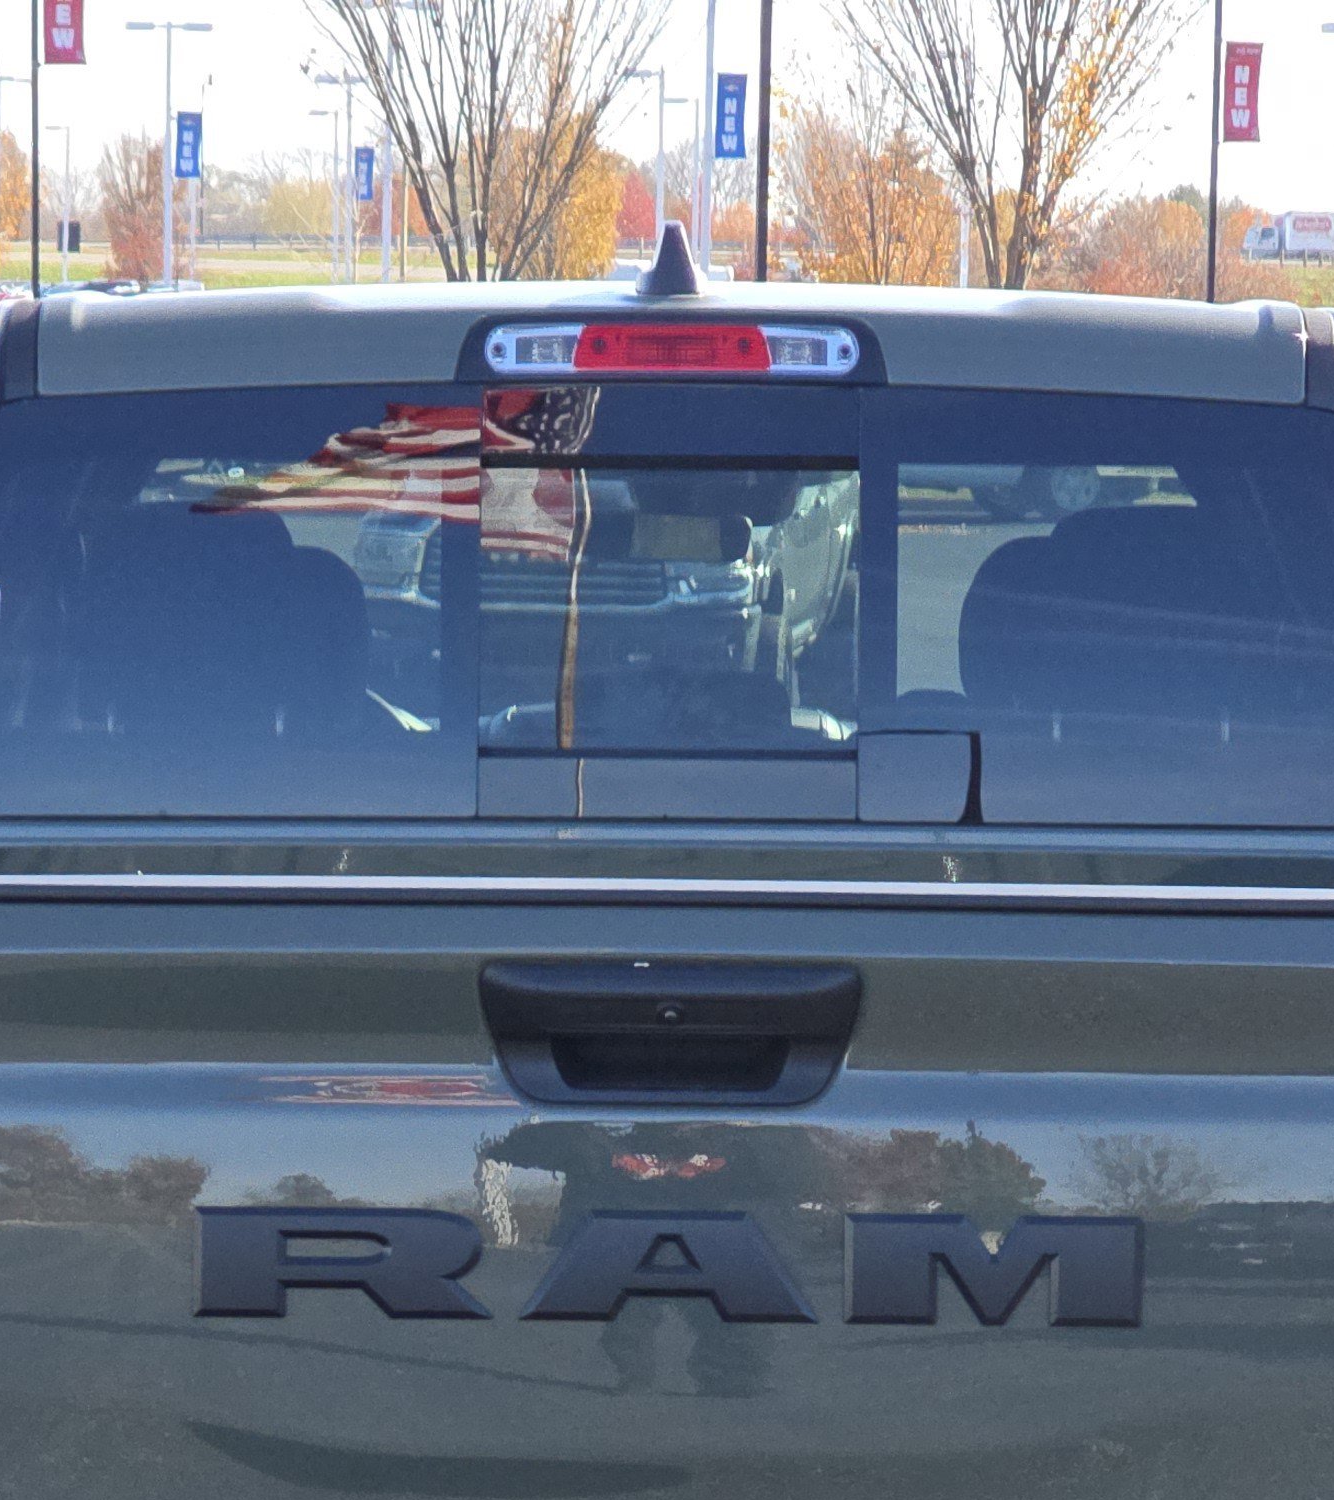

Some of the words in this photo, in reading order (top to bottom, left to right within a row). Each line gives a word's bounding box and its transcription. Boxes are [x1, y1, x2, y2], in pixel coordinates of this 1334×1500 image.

[51, 0, 75, 49] EW
[722, 97, 737, 151] NEW
[1231, 65, 1250, 128] NEW
[193, 1205, 1145, 1327] RAM
